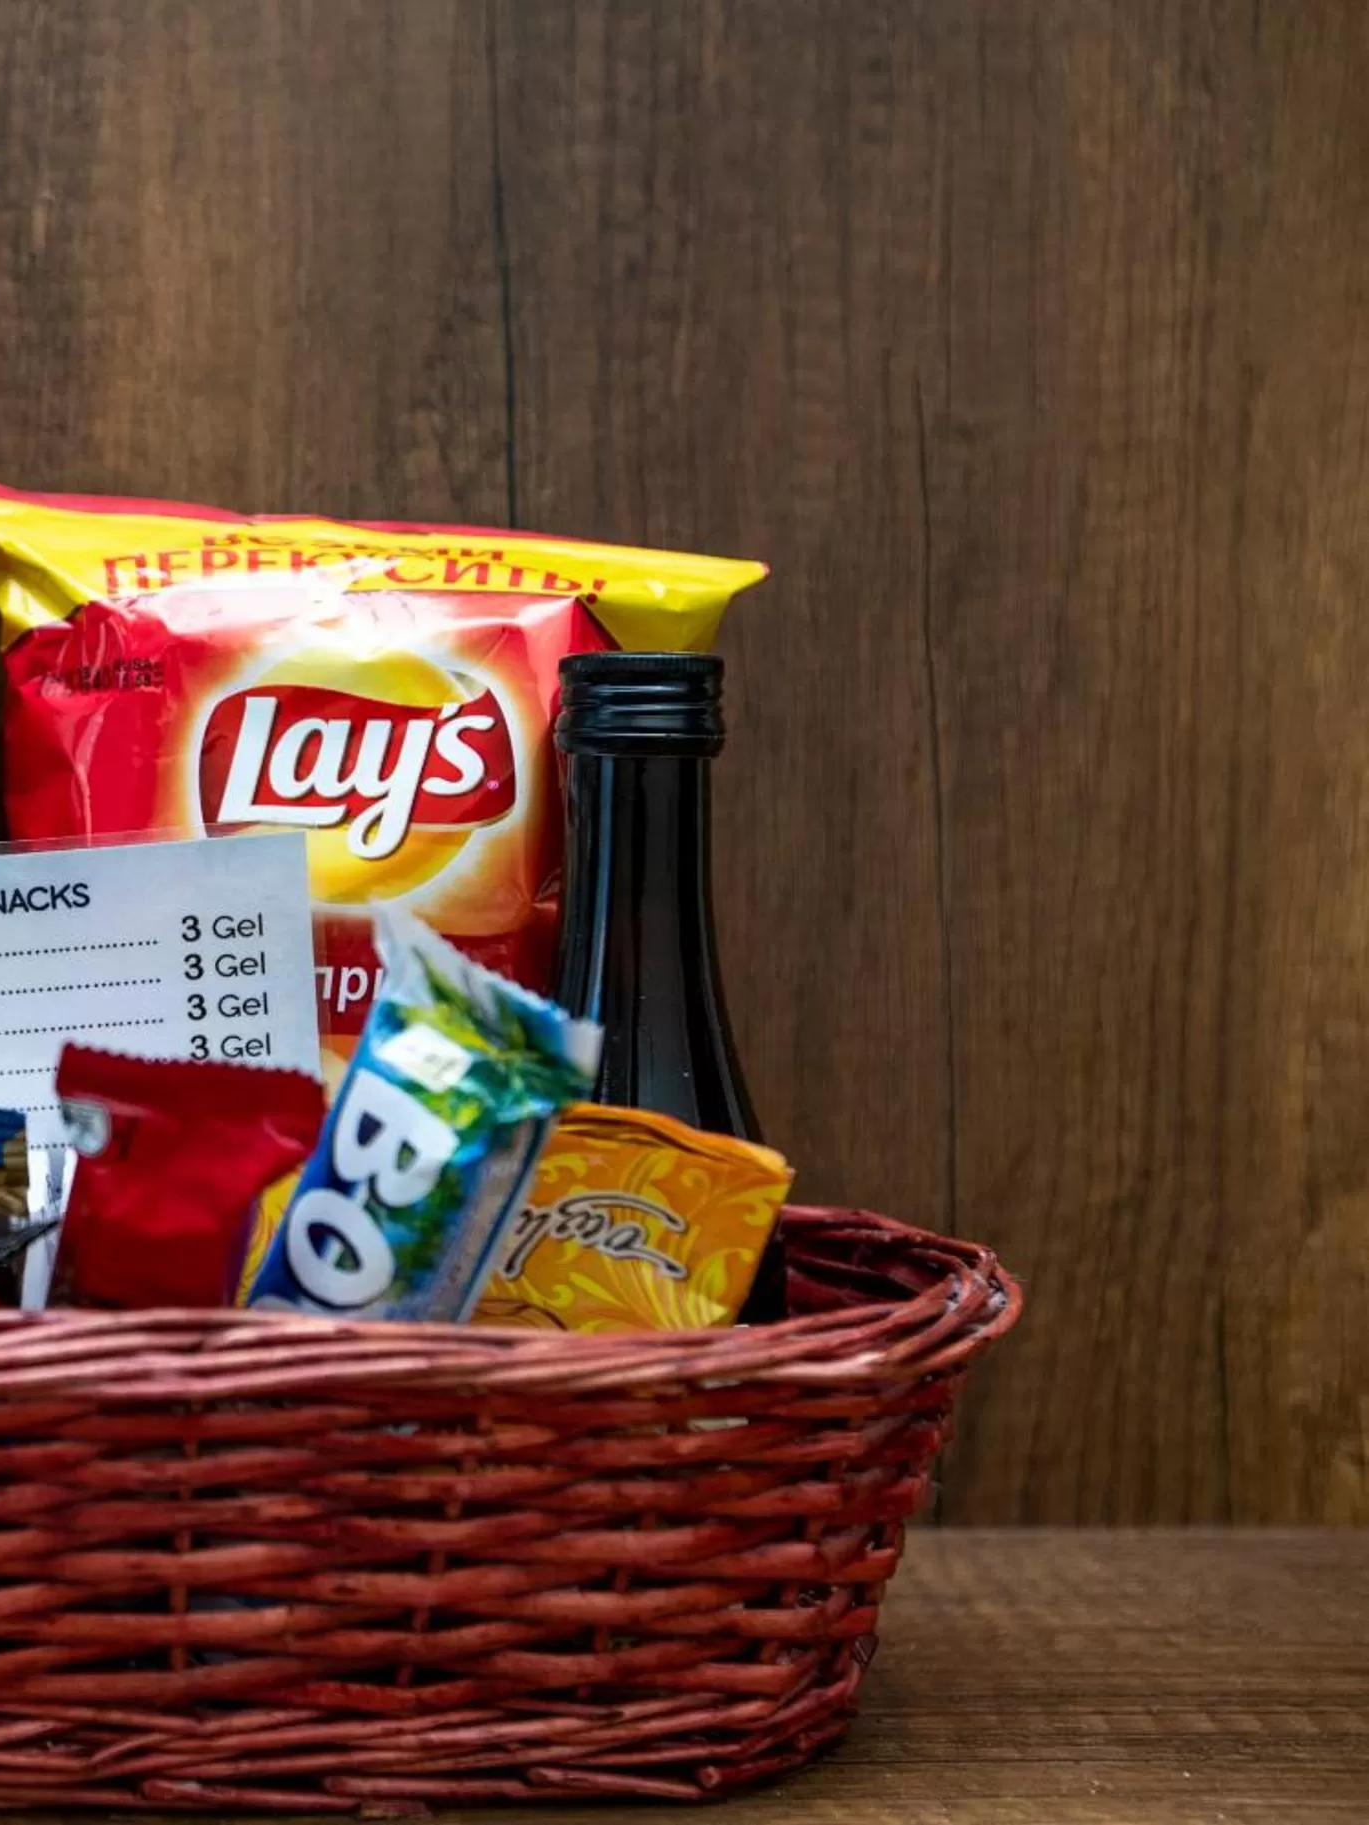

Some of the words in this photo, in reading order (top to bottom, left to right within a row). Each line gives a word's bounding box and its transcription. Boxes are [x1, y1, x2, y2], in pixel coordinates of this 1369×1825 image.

[218, 696, 495, 860] Lay's
[181, 914, 202, 943] 3
[211, 911, 265, 940] Gel
[184, 953, 205, 981] 3
[214, 951, 267, 978] Gel
[186, 993, 208, 1021] 3
[217, 991, 269, 1019] Gel
[189, 1034, 211, 1061] 3
[220, 1031, 272, 1059] Gel
[285, 1066, 461, 1311] BO
